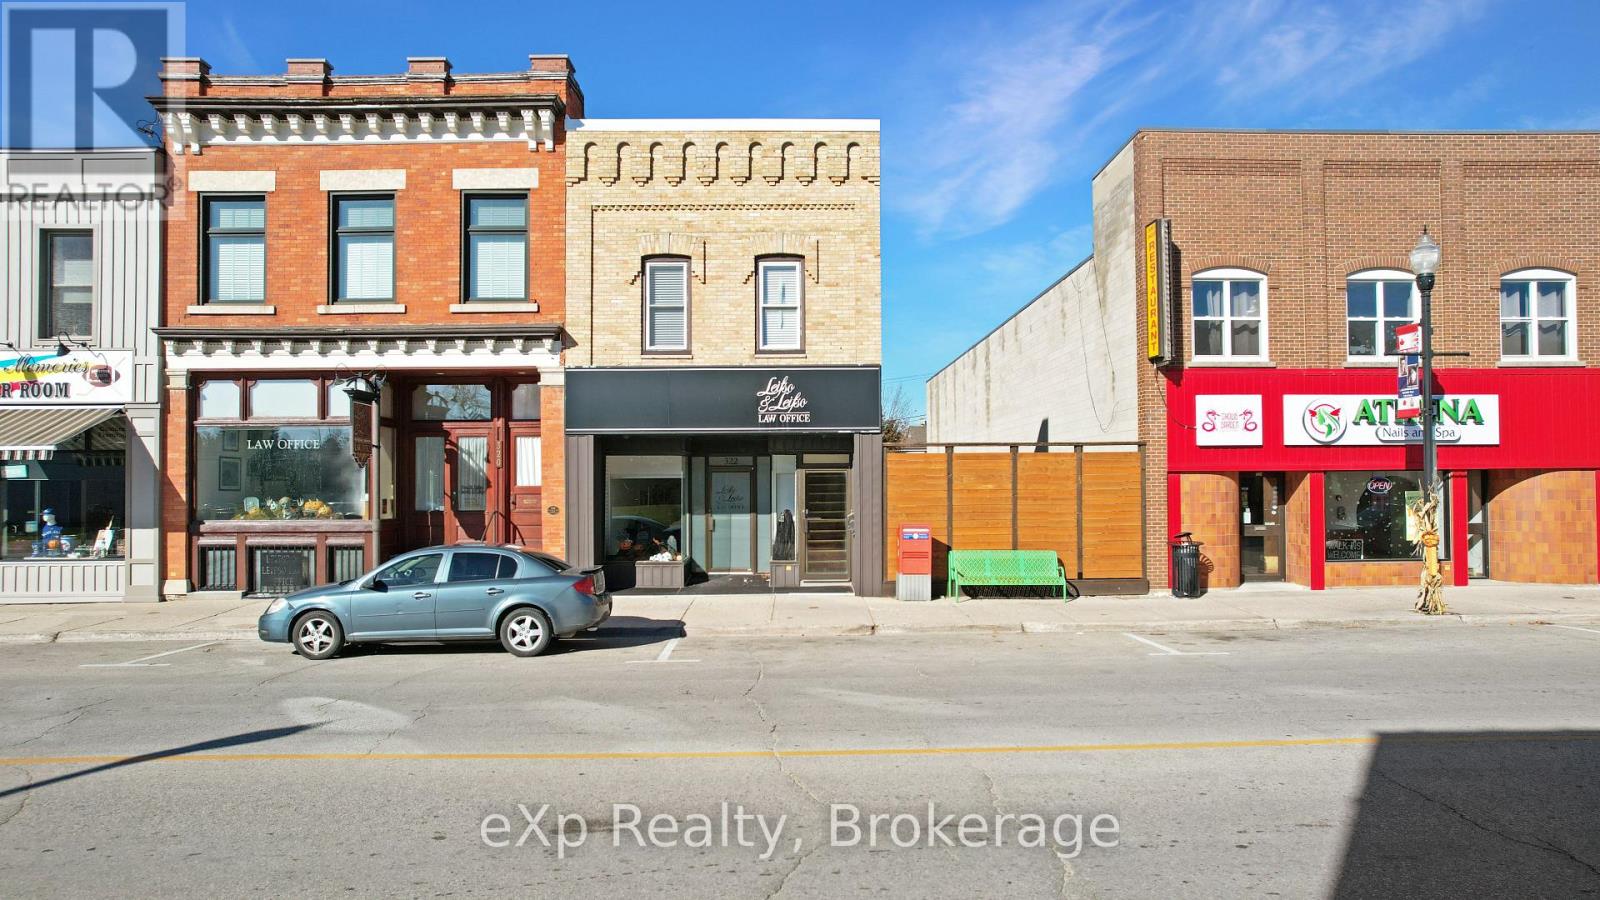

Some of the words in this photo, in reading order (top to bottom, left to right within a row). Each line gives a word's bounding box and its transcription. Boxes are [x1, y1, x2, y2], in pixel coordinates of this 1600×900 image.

[1149, 240, 1157, 352] RESTAURANT
[4, 355, 90, 374] Memories
[20, 382, 71, 398] ROOM
[758, 395, 775, 413] &
[758, 414, 777, 423] LAW
[779, 413, 811, 423] OFFICE
[1382, 426, 1409, 438] Nails
[1435, 426, 1455, 442] Spa
[247, 439, 274, 450] LAW
[277, 439, 320, 450] OFFICE
[1368, 480, 1390, 490] OPEN
[1327, 541, 1361, 550] WALK-INS
